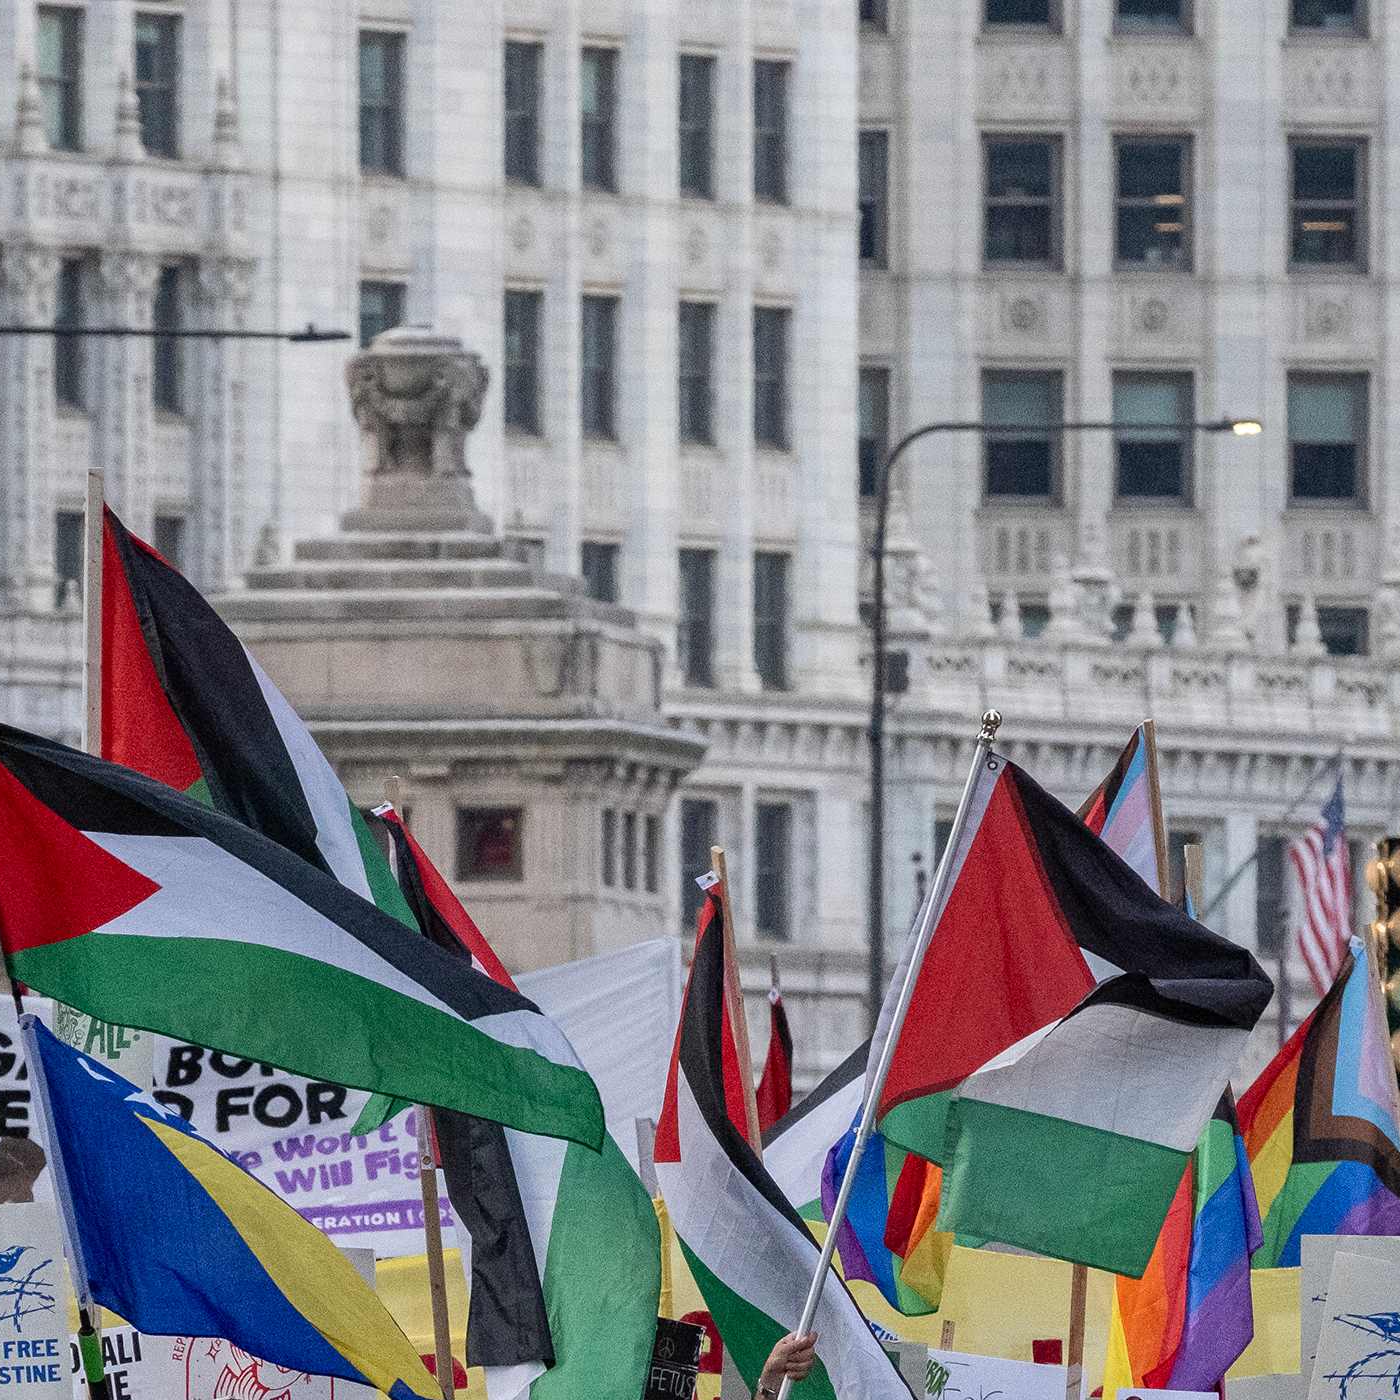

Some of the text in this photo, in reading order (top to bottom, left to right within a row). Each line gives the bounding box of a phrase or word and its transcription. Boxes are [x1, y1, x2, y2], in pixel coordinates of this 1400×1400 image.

[84, 1020, 141, 1059] ALL
[215, 1083, 348, 1133] FOR
[275, 1148, 420, 1194] Will Fig
[312, 1210, 401, 1229] ERATION
[3, 1338, 59, 1359] FREE
[650, 1366, 696, 1400] FETUS
